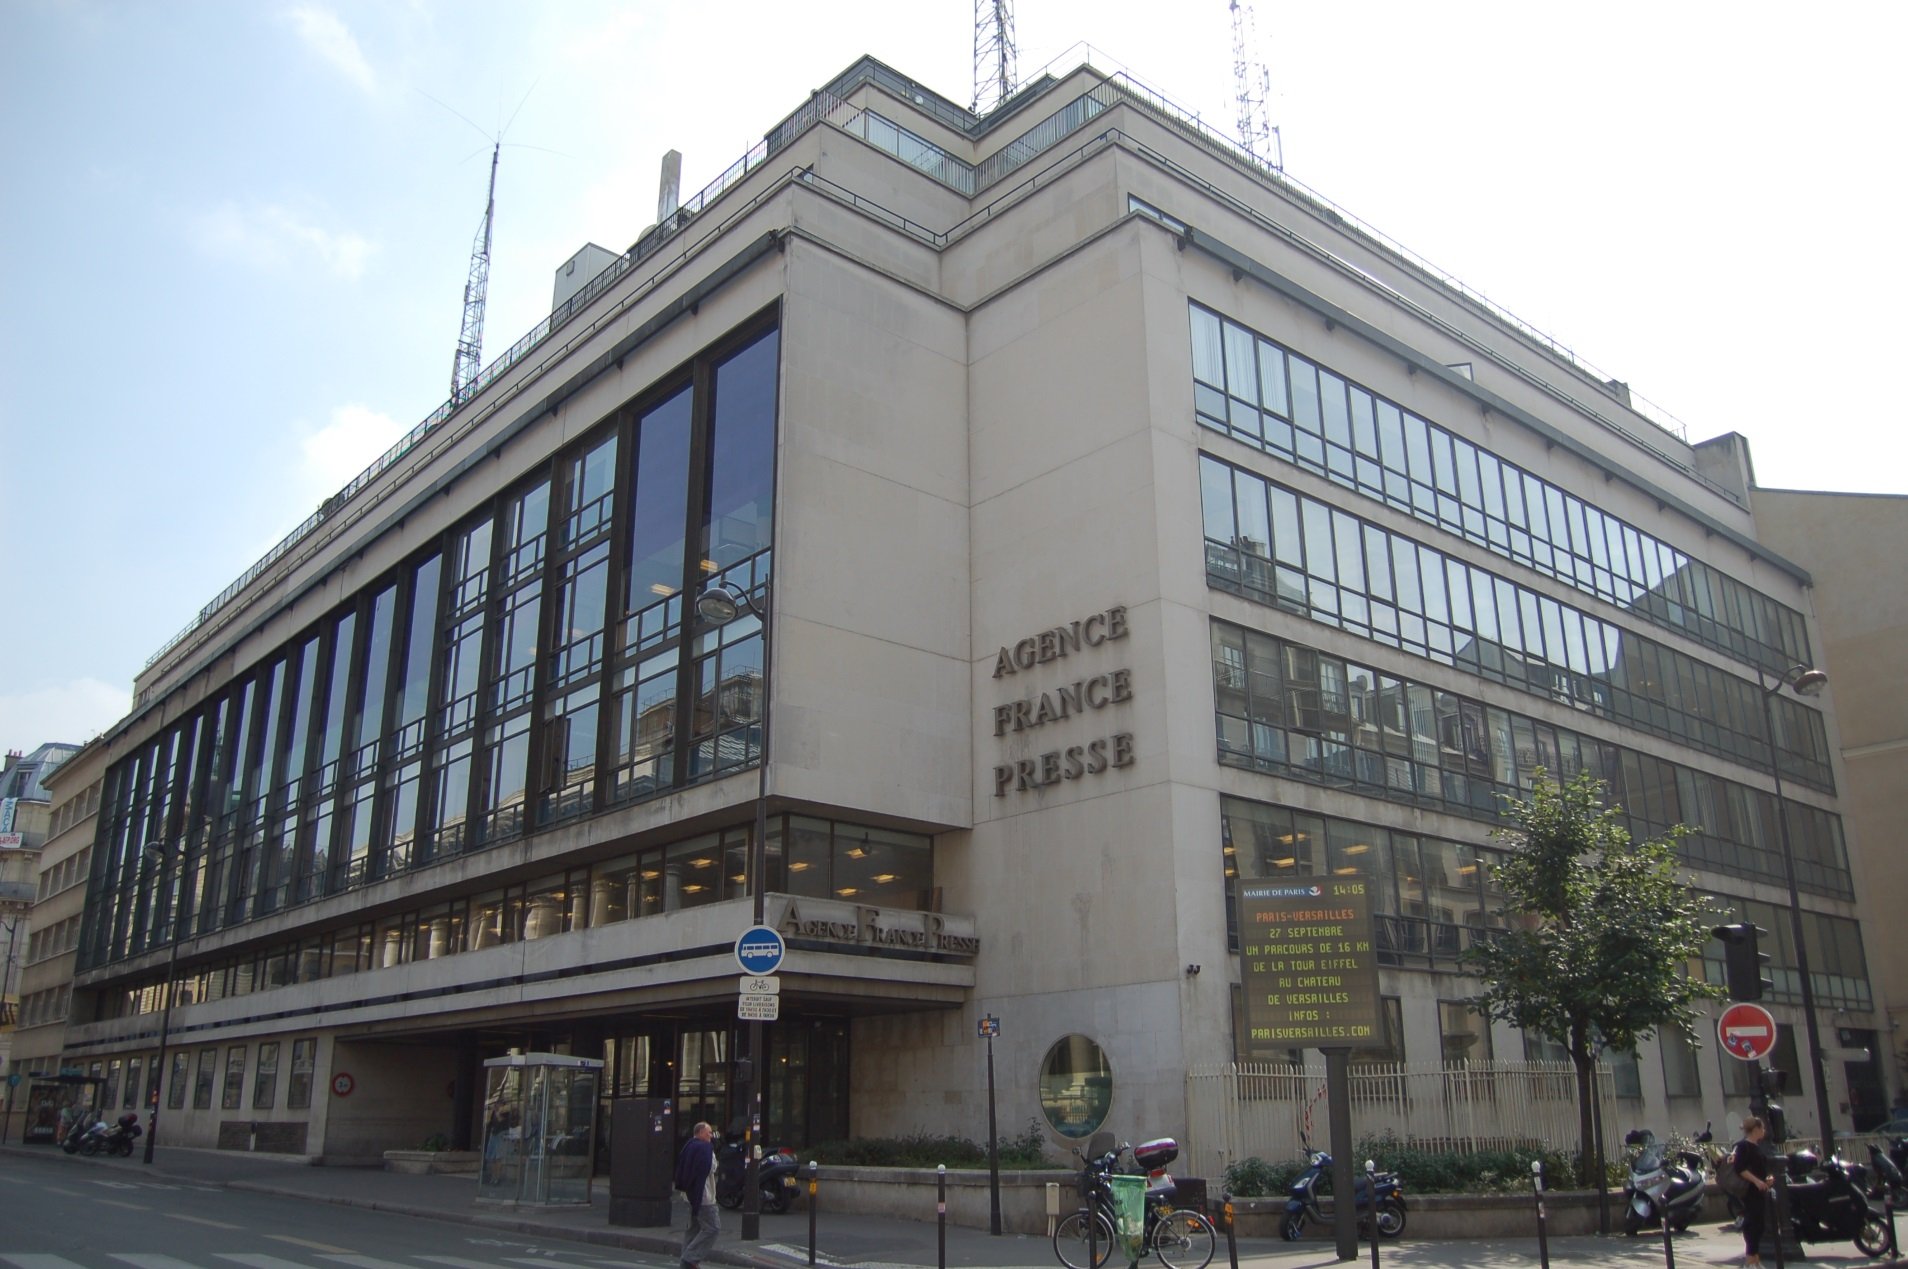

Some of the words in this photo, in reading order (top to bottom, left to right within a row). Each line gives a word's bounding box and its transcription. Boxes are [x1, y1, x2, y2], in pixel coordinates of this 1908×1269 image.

[992, 605, 1129, 678] AGENCE
[993, 668, 1133, 736] FRANCE
[993, 732, 1135, 797] PRESSE
[1284, 888, 1305, 896] PARIS
[1333, 884, 1365, 895] 14:05
[1256, 909, 1354, 923] PARIS-VERSAILLES
[1269, 928, 1281, 939] 27
[1287, 926, 1343, 938] SEPTEMBRE
[1246, 945, 1259, 955] UN
[1264, 944, 1314, 955] PARCOURS
[1319, 943, 1331, 953] DE
[1338, 942, 1350, 952] 16
[1356, 941, 1369, 952] KM
[1253, 962, 1265, 972] DE
[1271, 961, 1284, 971] LA
[1291, 960, 1315, 971] TOUR
[1321, 959, 1358, 970] EIFFEL
[1279, 977, 1291, 988] AU
[1297, 976, 1341, 987] CHATEAU
[1267, 994, 1280, 1005] DE
[1286, 992, 1349, 1004] VERSAILLES
[1289, 1010, 1319, 1021] INFOS
[1251, 1025, 1370, 1039] PARISVERSAILLES.COM
